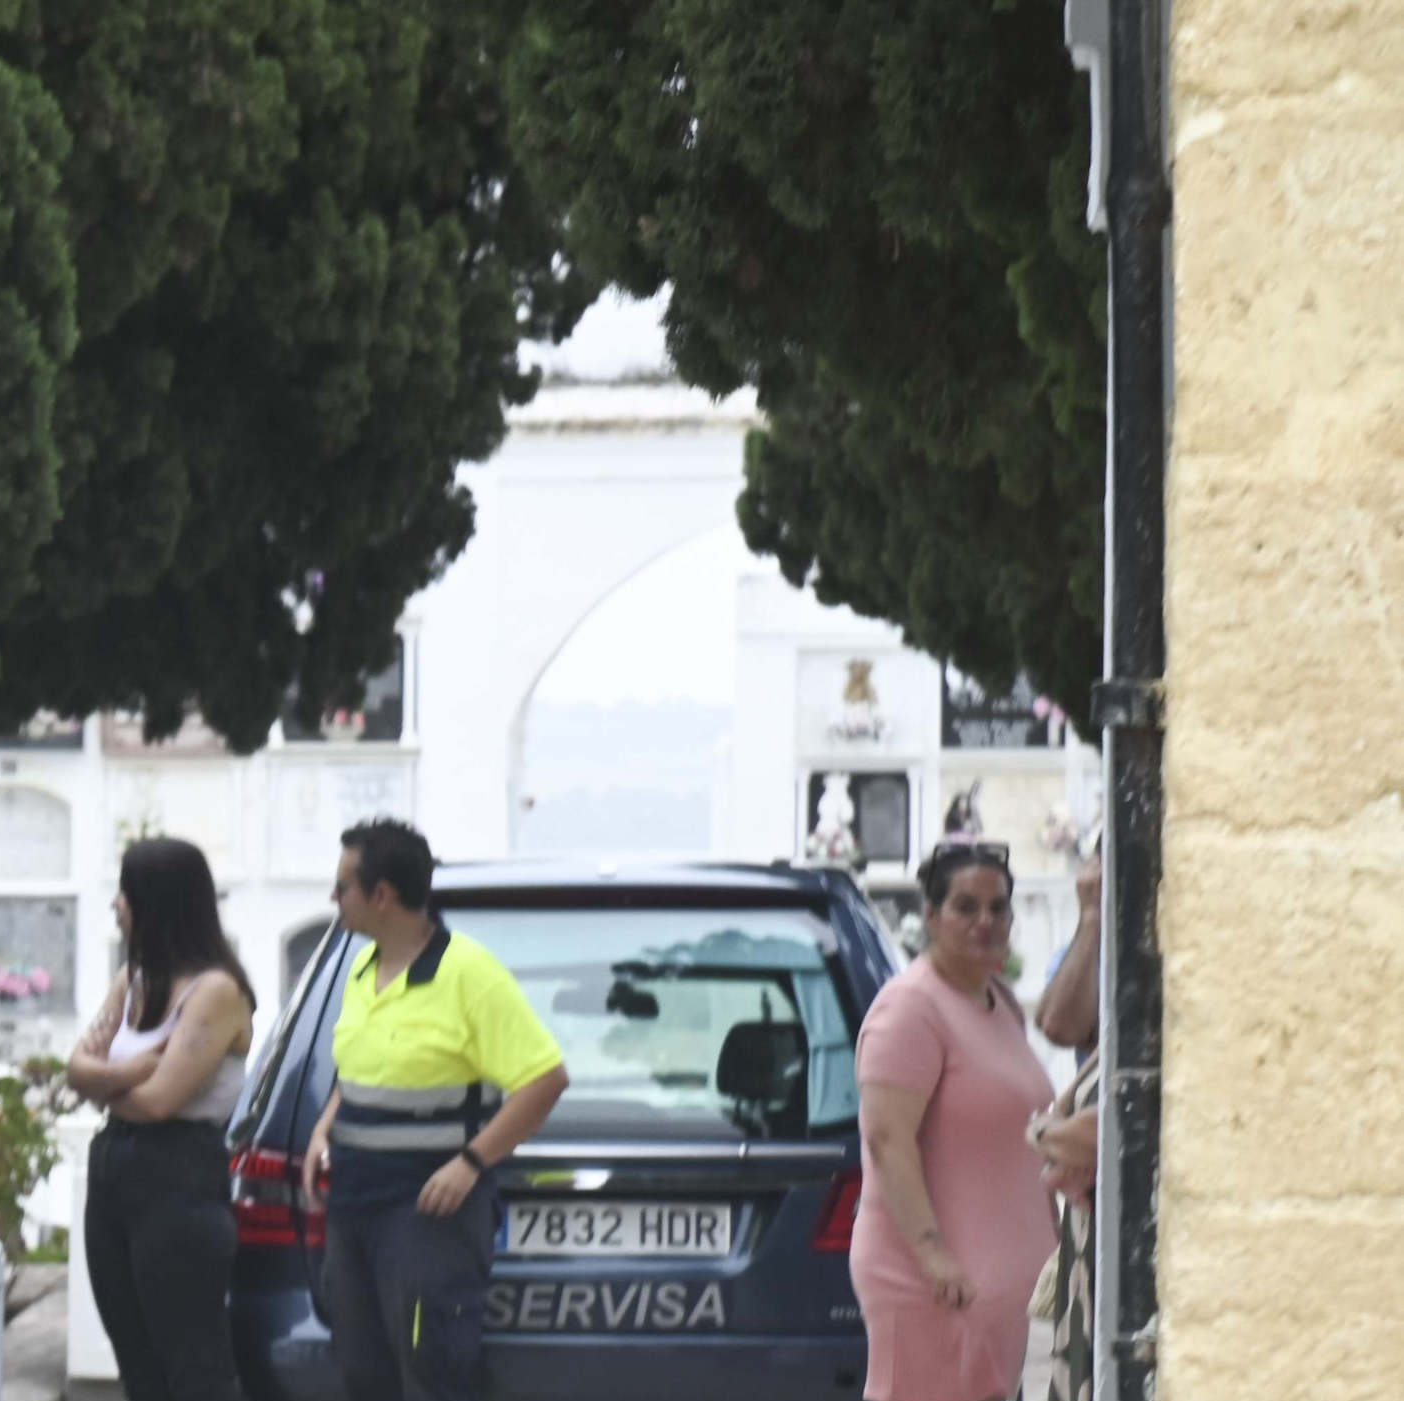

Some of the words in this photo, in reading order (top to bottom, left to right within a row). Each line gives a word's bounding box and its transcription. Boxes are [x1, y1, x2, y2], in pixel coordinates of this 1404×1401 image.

[515, 1207, 624, 1247] 7832
[639, 1206, 719, 1247] HDR
[482, 1279, 726, 1330] SERVISA
